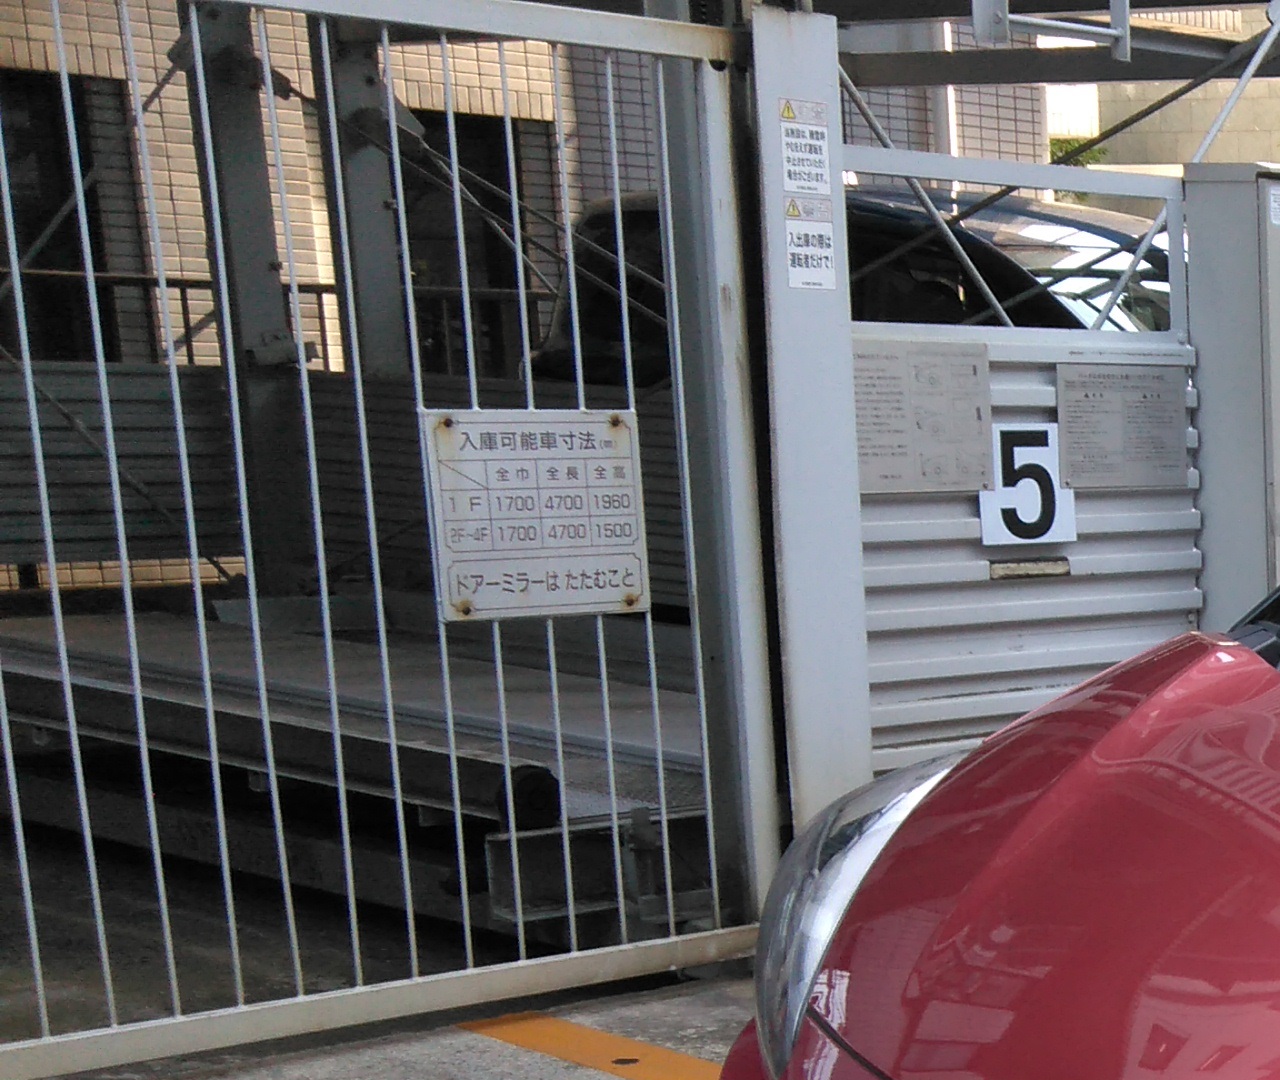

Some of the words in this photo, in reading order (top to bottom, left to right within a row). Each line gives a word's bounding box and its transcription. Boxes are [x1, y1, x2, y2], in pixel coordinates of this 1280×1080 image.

[999, 429, 1057, 540] 5
[496, 495, 535, 512] 1700
[544, 494, 583, 511] 4700
[593, 493, 631, 510] 1960
[498, 525, 537, 542] 1700
[548, 523, 587, 540] 4700
[596, 522, 632, 538] 1500
